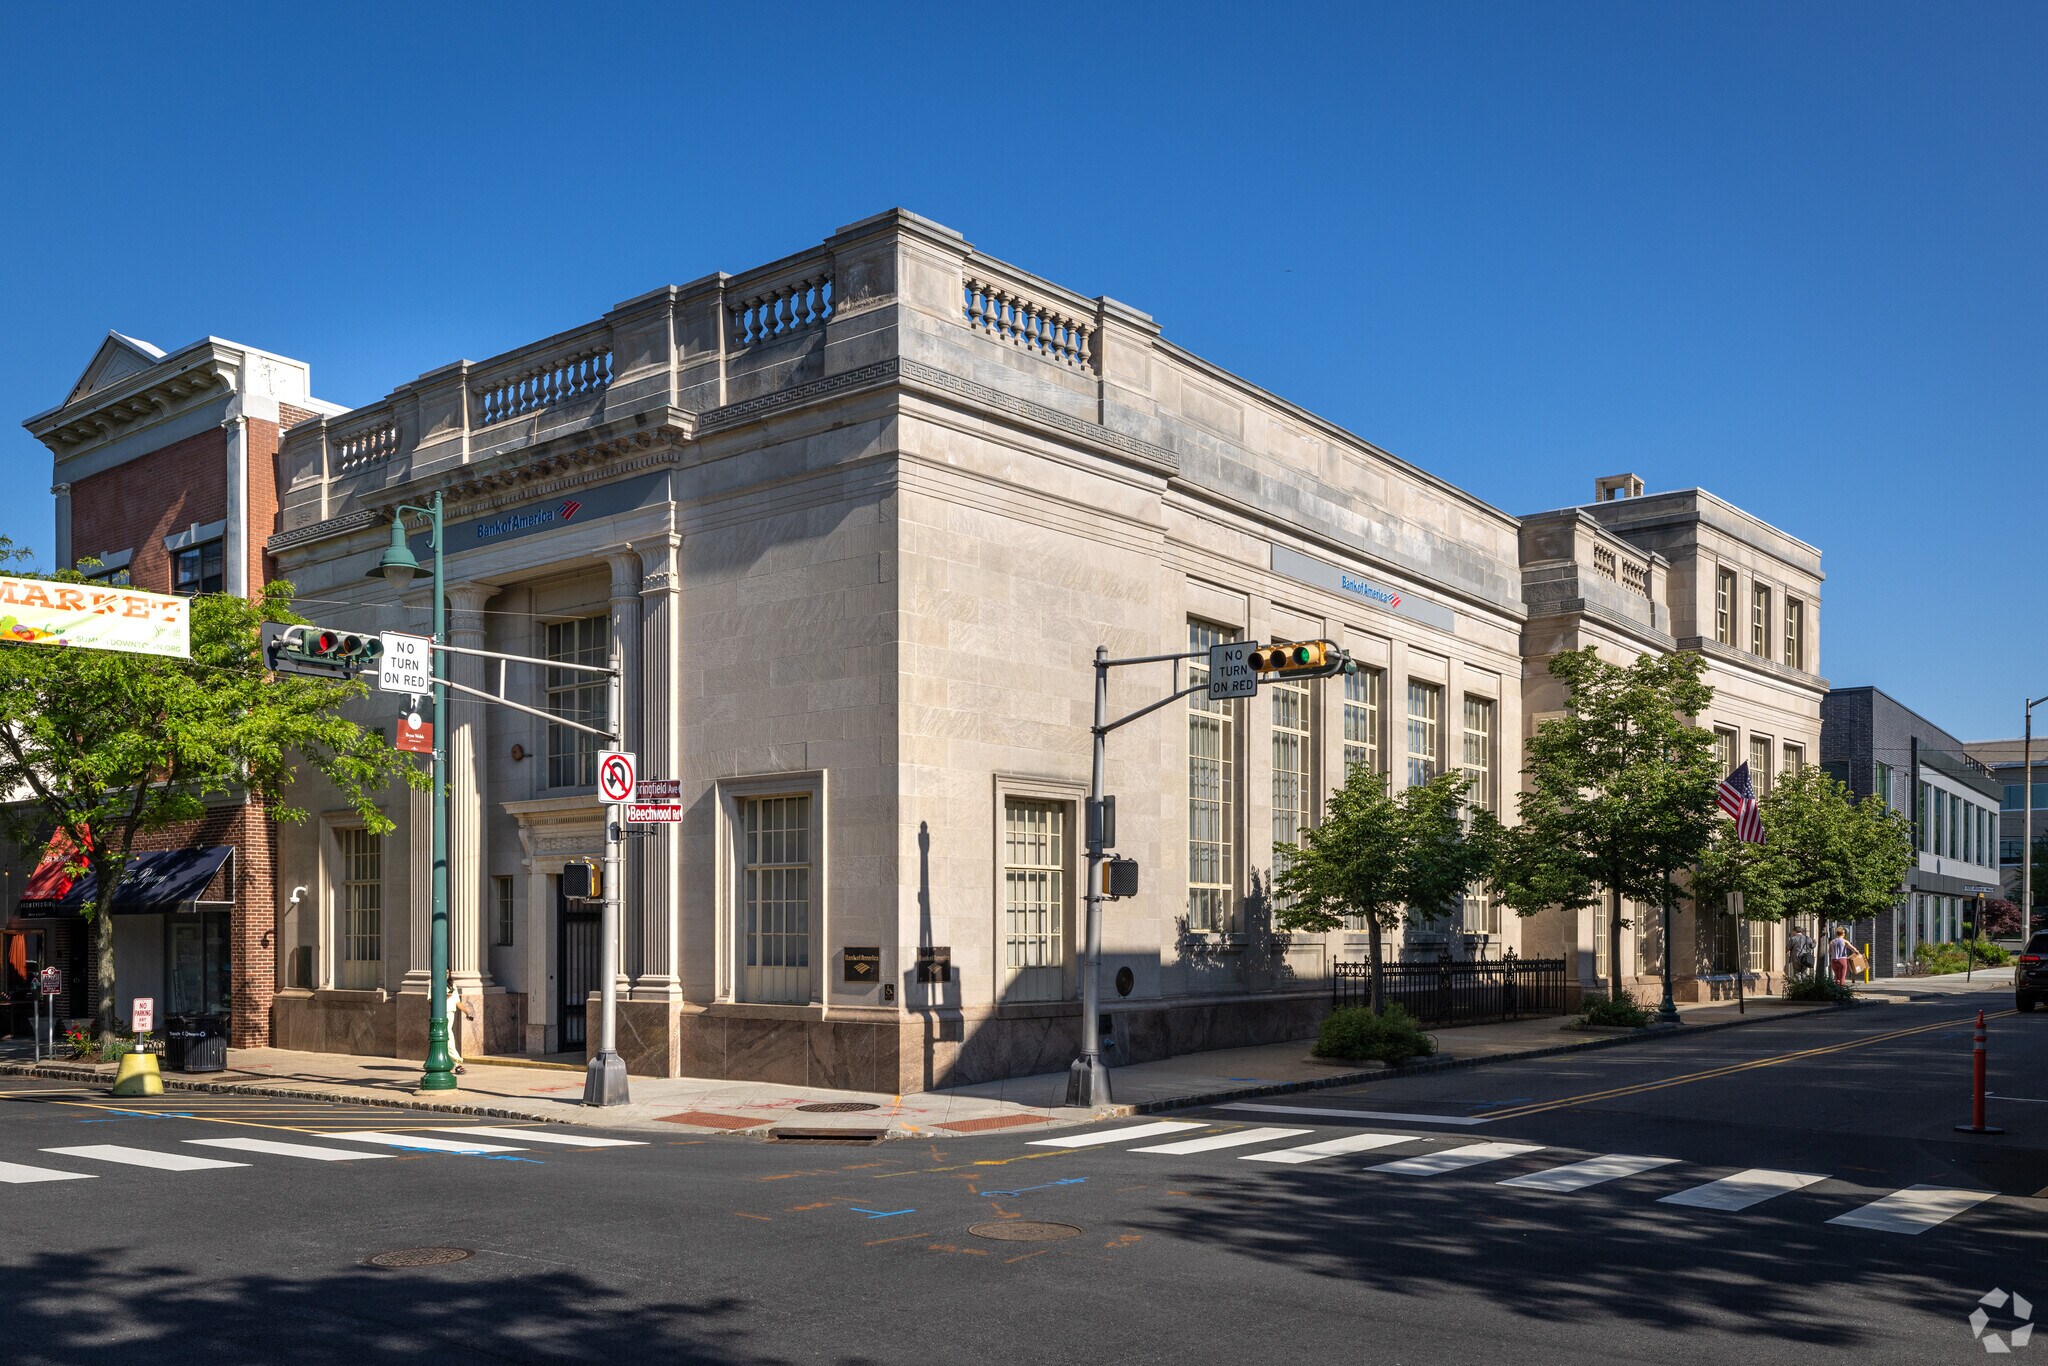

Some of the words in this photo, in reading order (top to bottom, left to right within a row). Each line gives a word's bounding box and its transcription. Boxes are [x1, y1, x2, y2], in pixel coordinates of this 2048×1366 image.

[396, 641, 414, 654] NO
[1225, 650, 1242, 661] NO
[391, 657, 419, 671] TURN
[1220, 664, 1247, 677] TURN
[384, 672, 399, 684] ON
[404, 674, 424, 687] RED
[1213, 682, 1228, 693] ON
[1232, 679, 1253, 691] RED
[636, 783, 667, 797] ringfield
[668, 784, 678, 793] Ave
[630, 806, 671, 821] Beechwood
[672, 809, 680, 821] Rd
